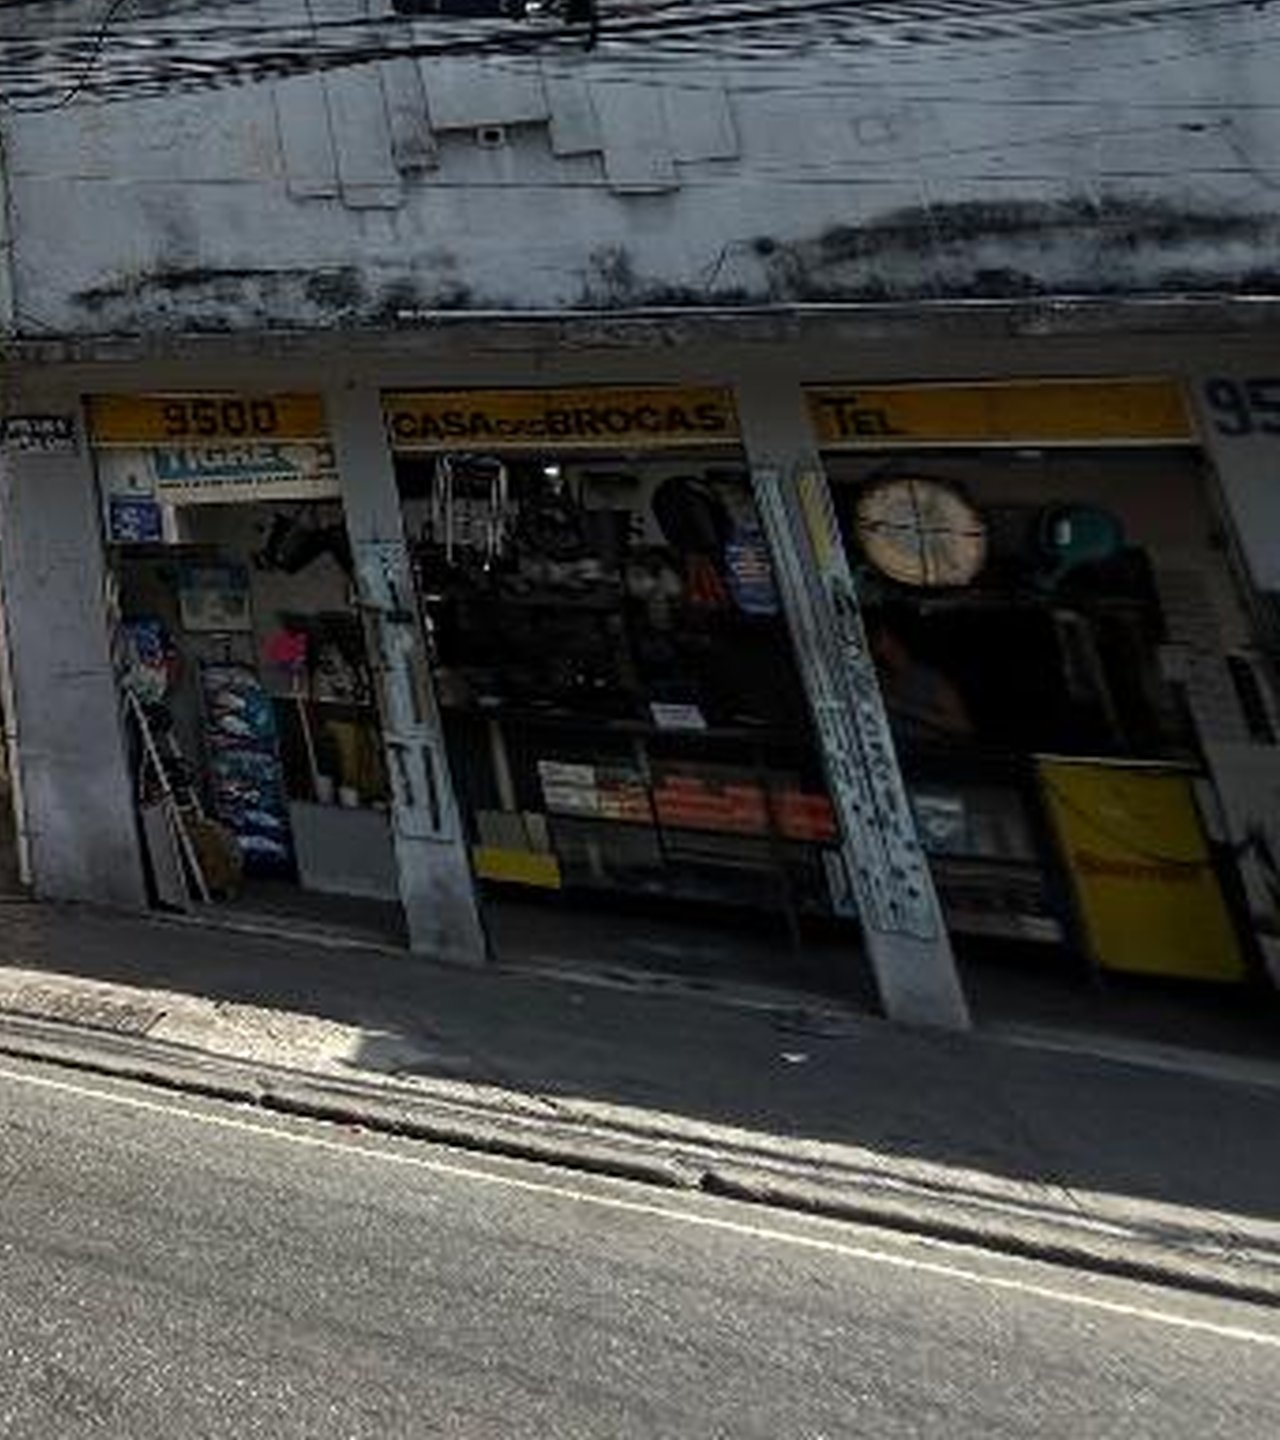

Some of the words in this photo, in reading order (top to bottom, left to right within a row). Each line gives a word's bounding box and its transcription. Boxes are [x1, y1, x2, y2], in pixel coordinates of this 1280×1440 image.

[163, 400, 277, 436] 9500
[391, 411, 494, 441] CASA
[545, 404, 727, 436] BROCAS
